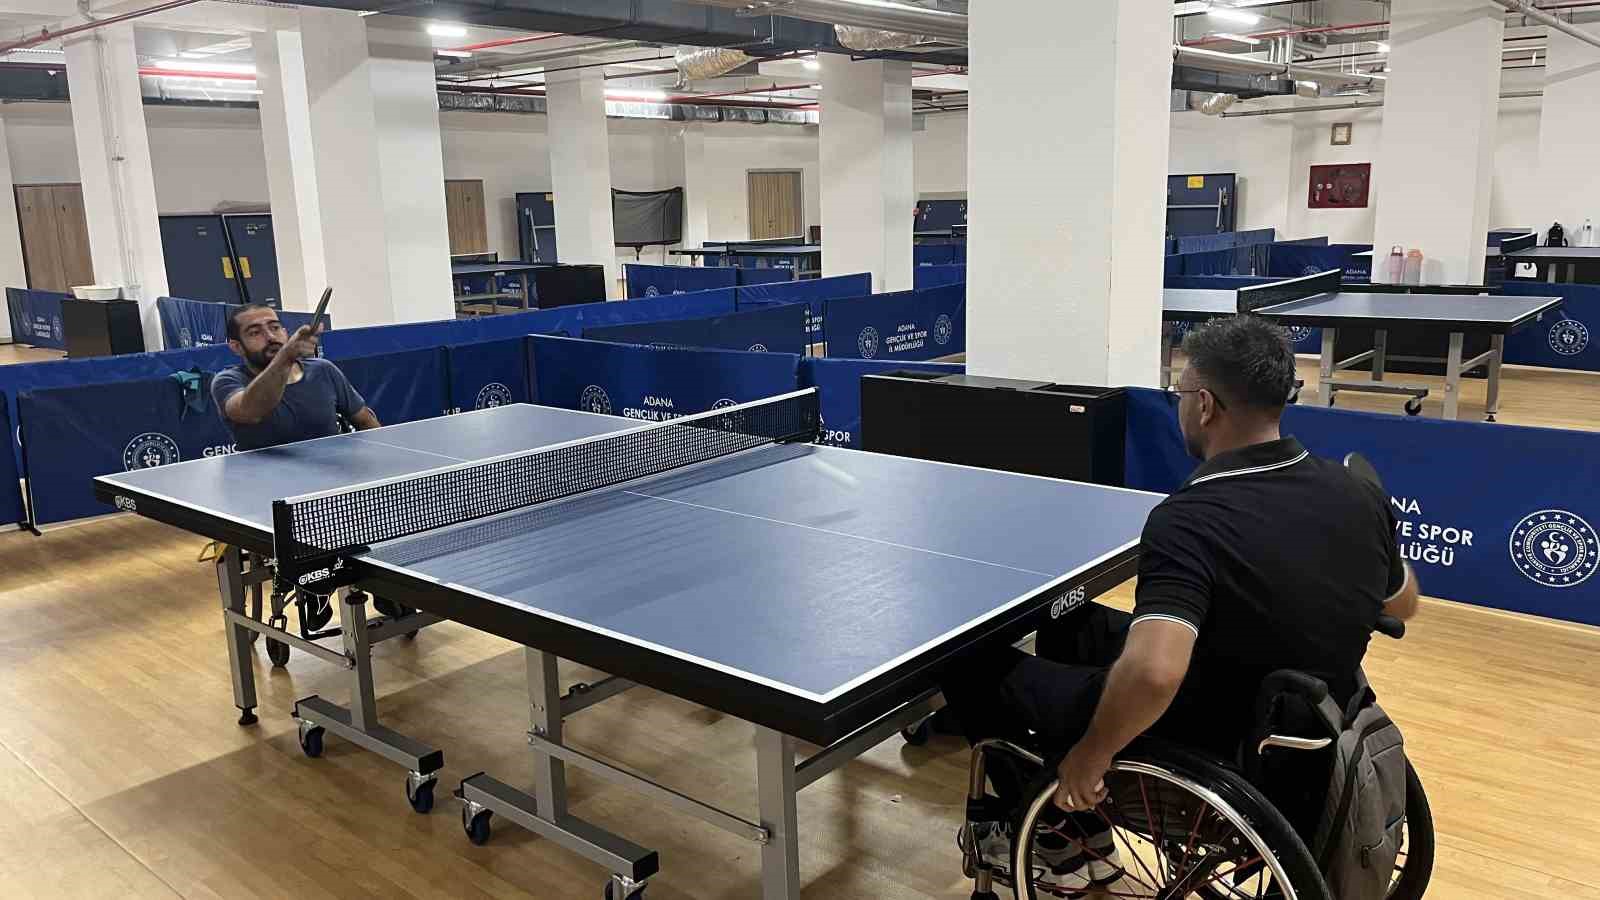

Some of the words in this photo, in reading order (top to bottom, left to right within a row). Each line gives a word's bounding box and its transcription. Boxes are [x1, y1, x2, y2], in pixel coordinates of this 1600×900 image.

[643, 396, 674, 408] ADANA
[1418, 523, 1473, 546] SPOR
[307, 568, 330, 581] KBS
[1060, 586, 1085, 611] KBS
